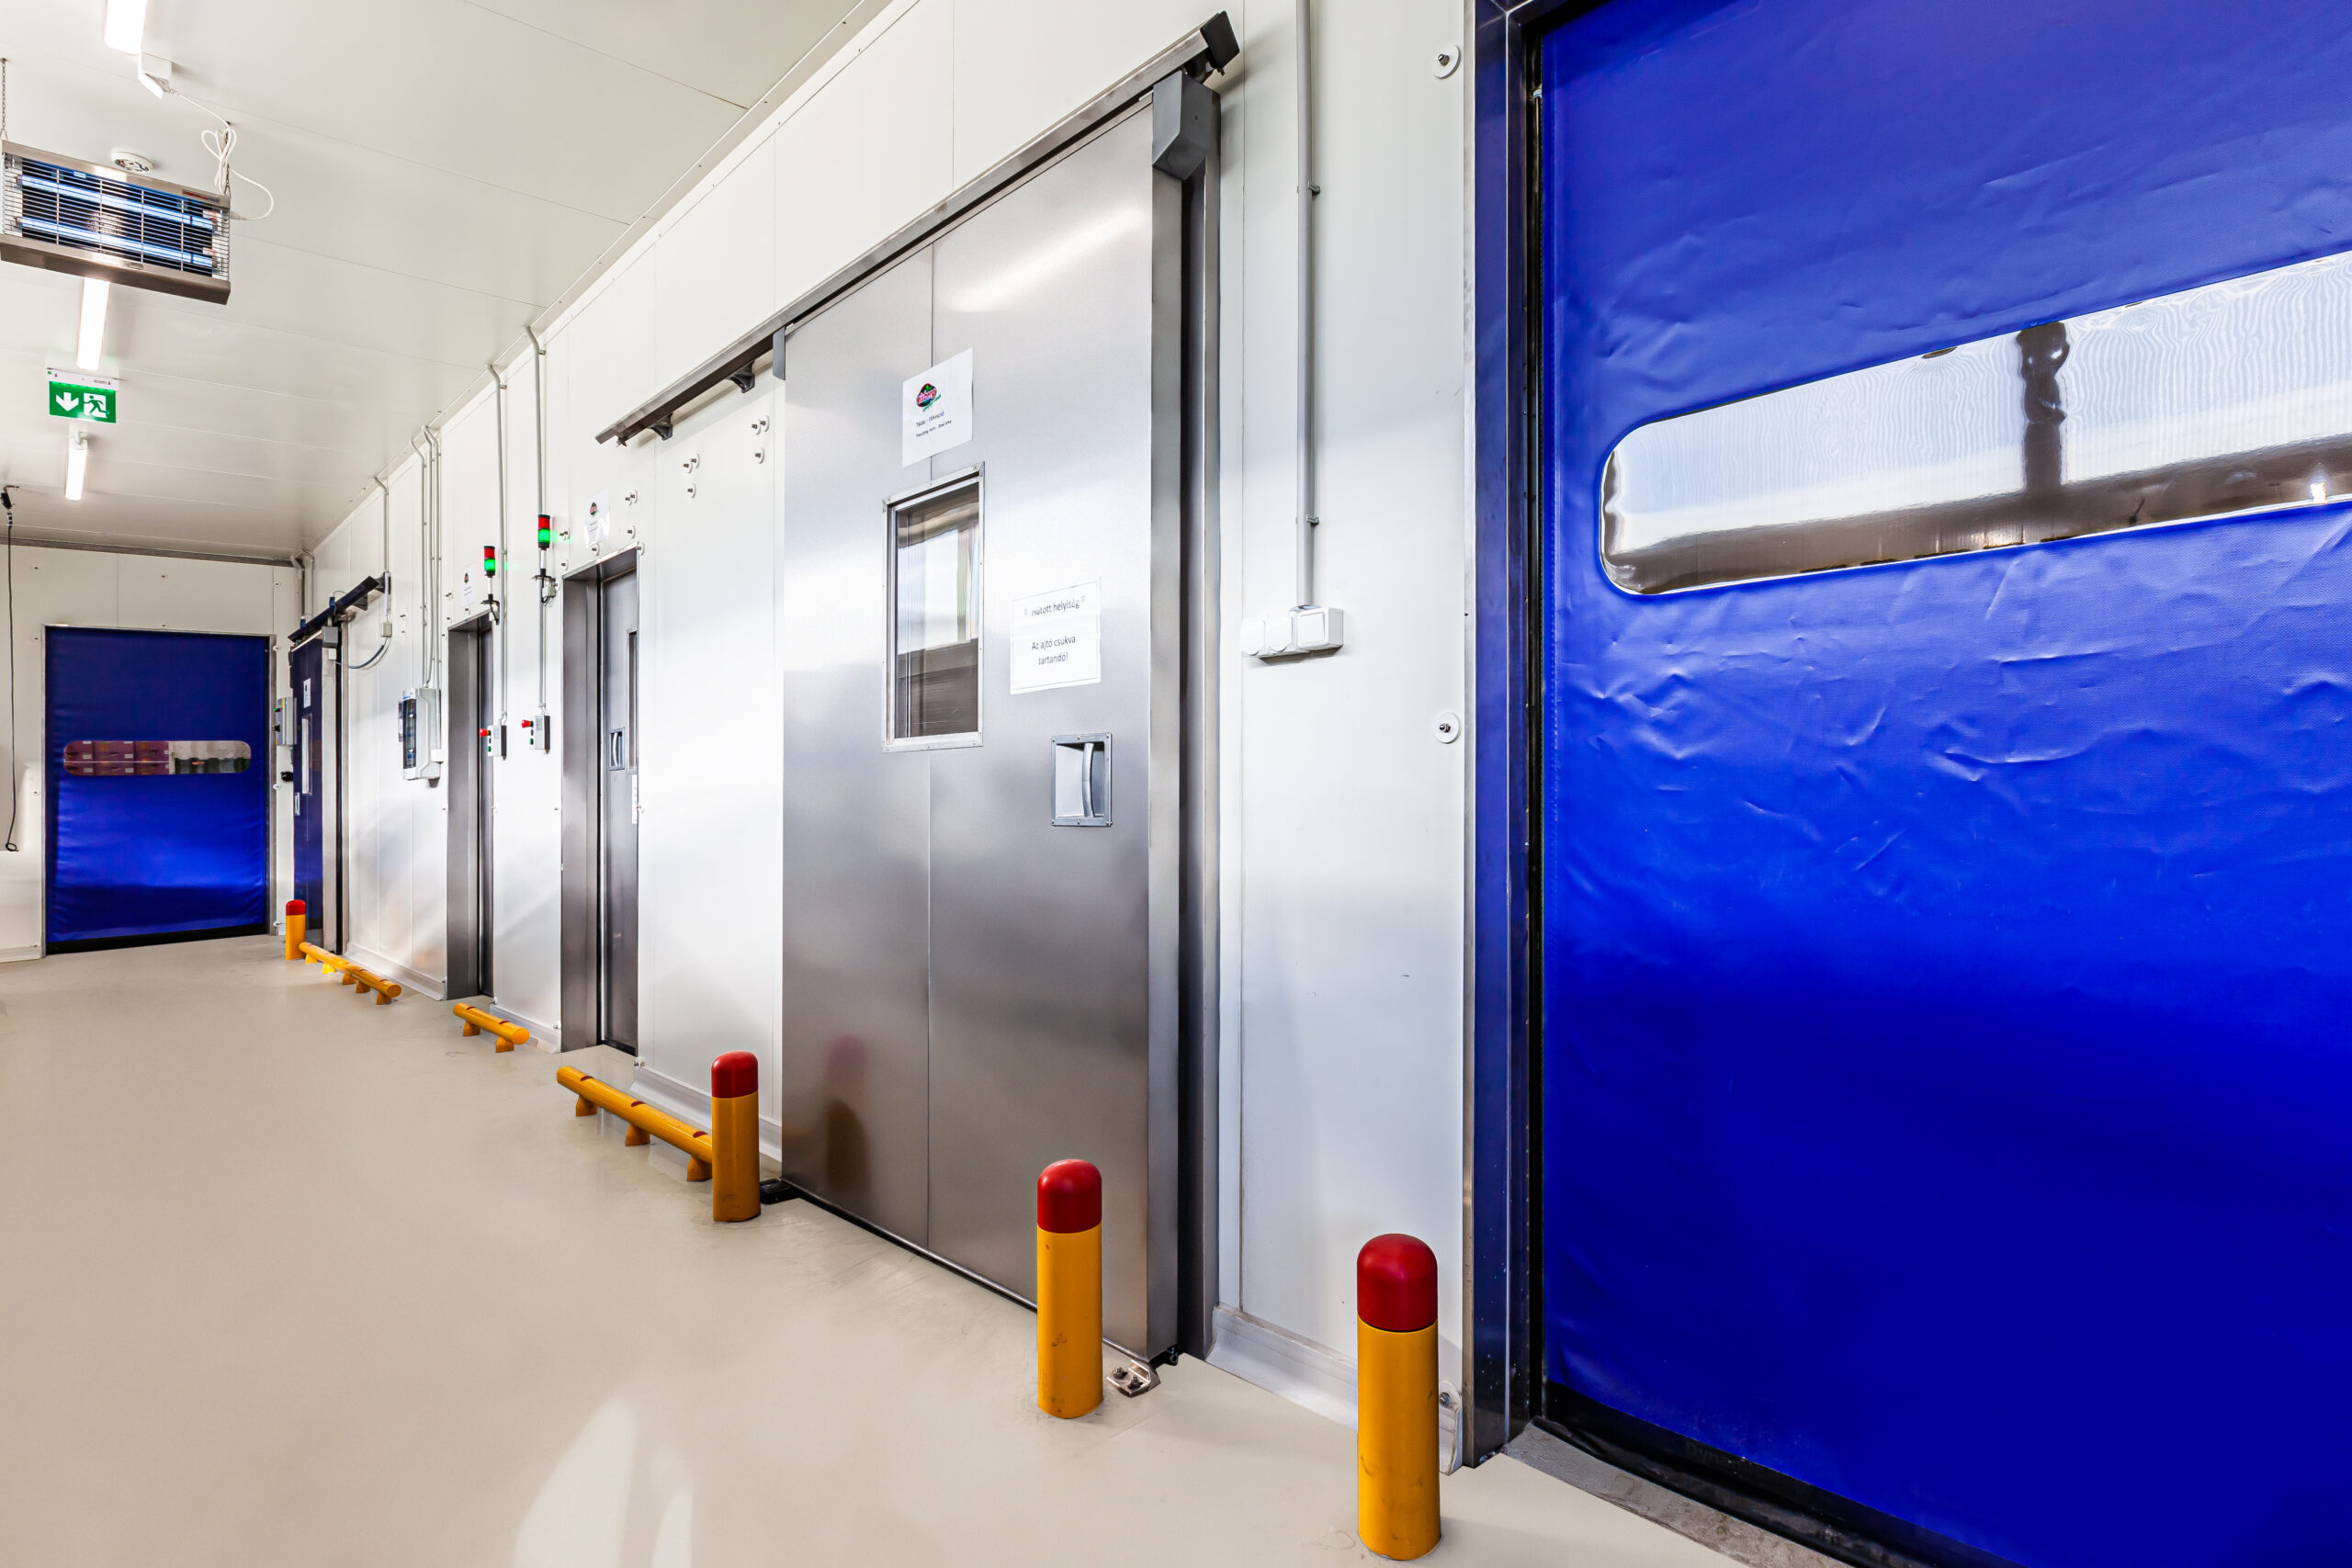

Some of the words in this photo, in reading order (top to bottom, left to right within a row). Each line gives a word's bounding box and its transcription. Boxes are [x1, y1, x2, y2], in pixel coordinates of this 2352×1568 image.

[1032, 641, 1039, 650] Az
[1040, 637, 1053, 650] ajtó
[1054, 635, 1076, 647] csukva
[1038, 651, 1069, 665] tartandó!
